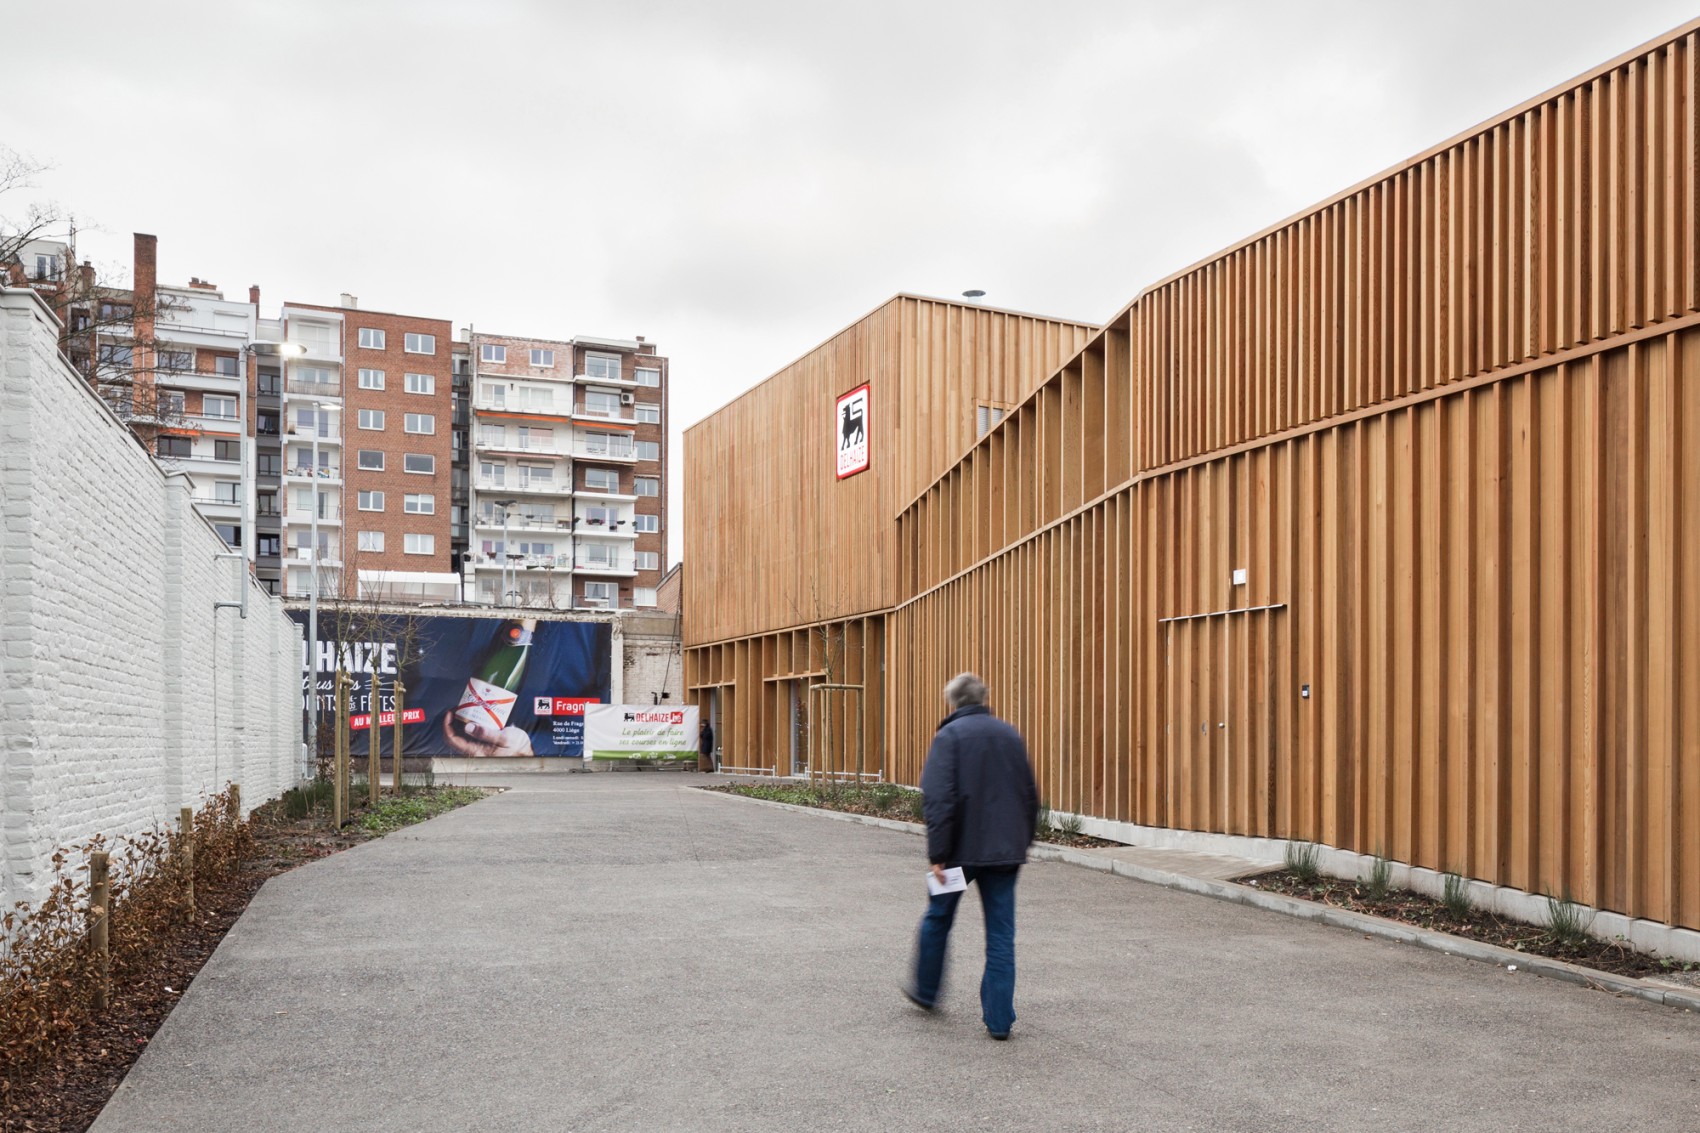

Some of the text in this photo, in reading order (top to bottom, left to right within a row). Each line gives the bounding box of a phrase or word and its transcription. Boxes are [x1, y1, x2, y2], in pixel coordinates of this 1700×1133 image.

[302, 640, 397, 674] LHAIZE
[302, 675, 334, 690] tus
[556, 701, 585, 714] Fragn
[354, 717, 364, 727] AU
[403, 710, 420, 721] PRIX
[635, 712, 669, 723] DELHAIZE
[667, 728, 683, 737] faire
[669, 739, 687, 749] ligne
